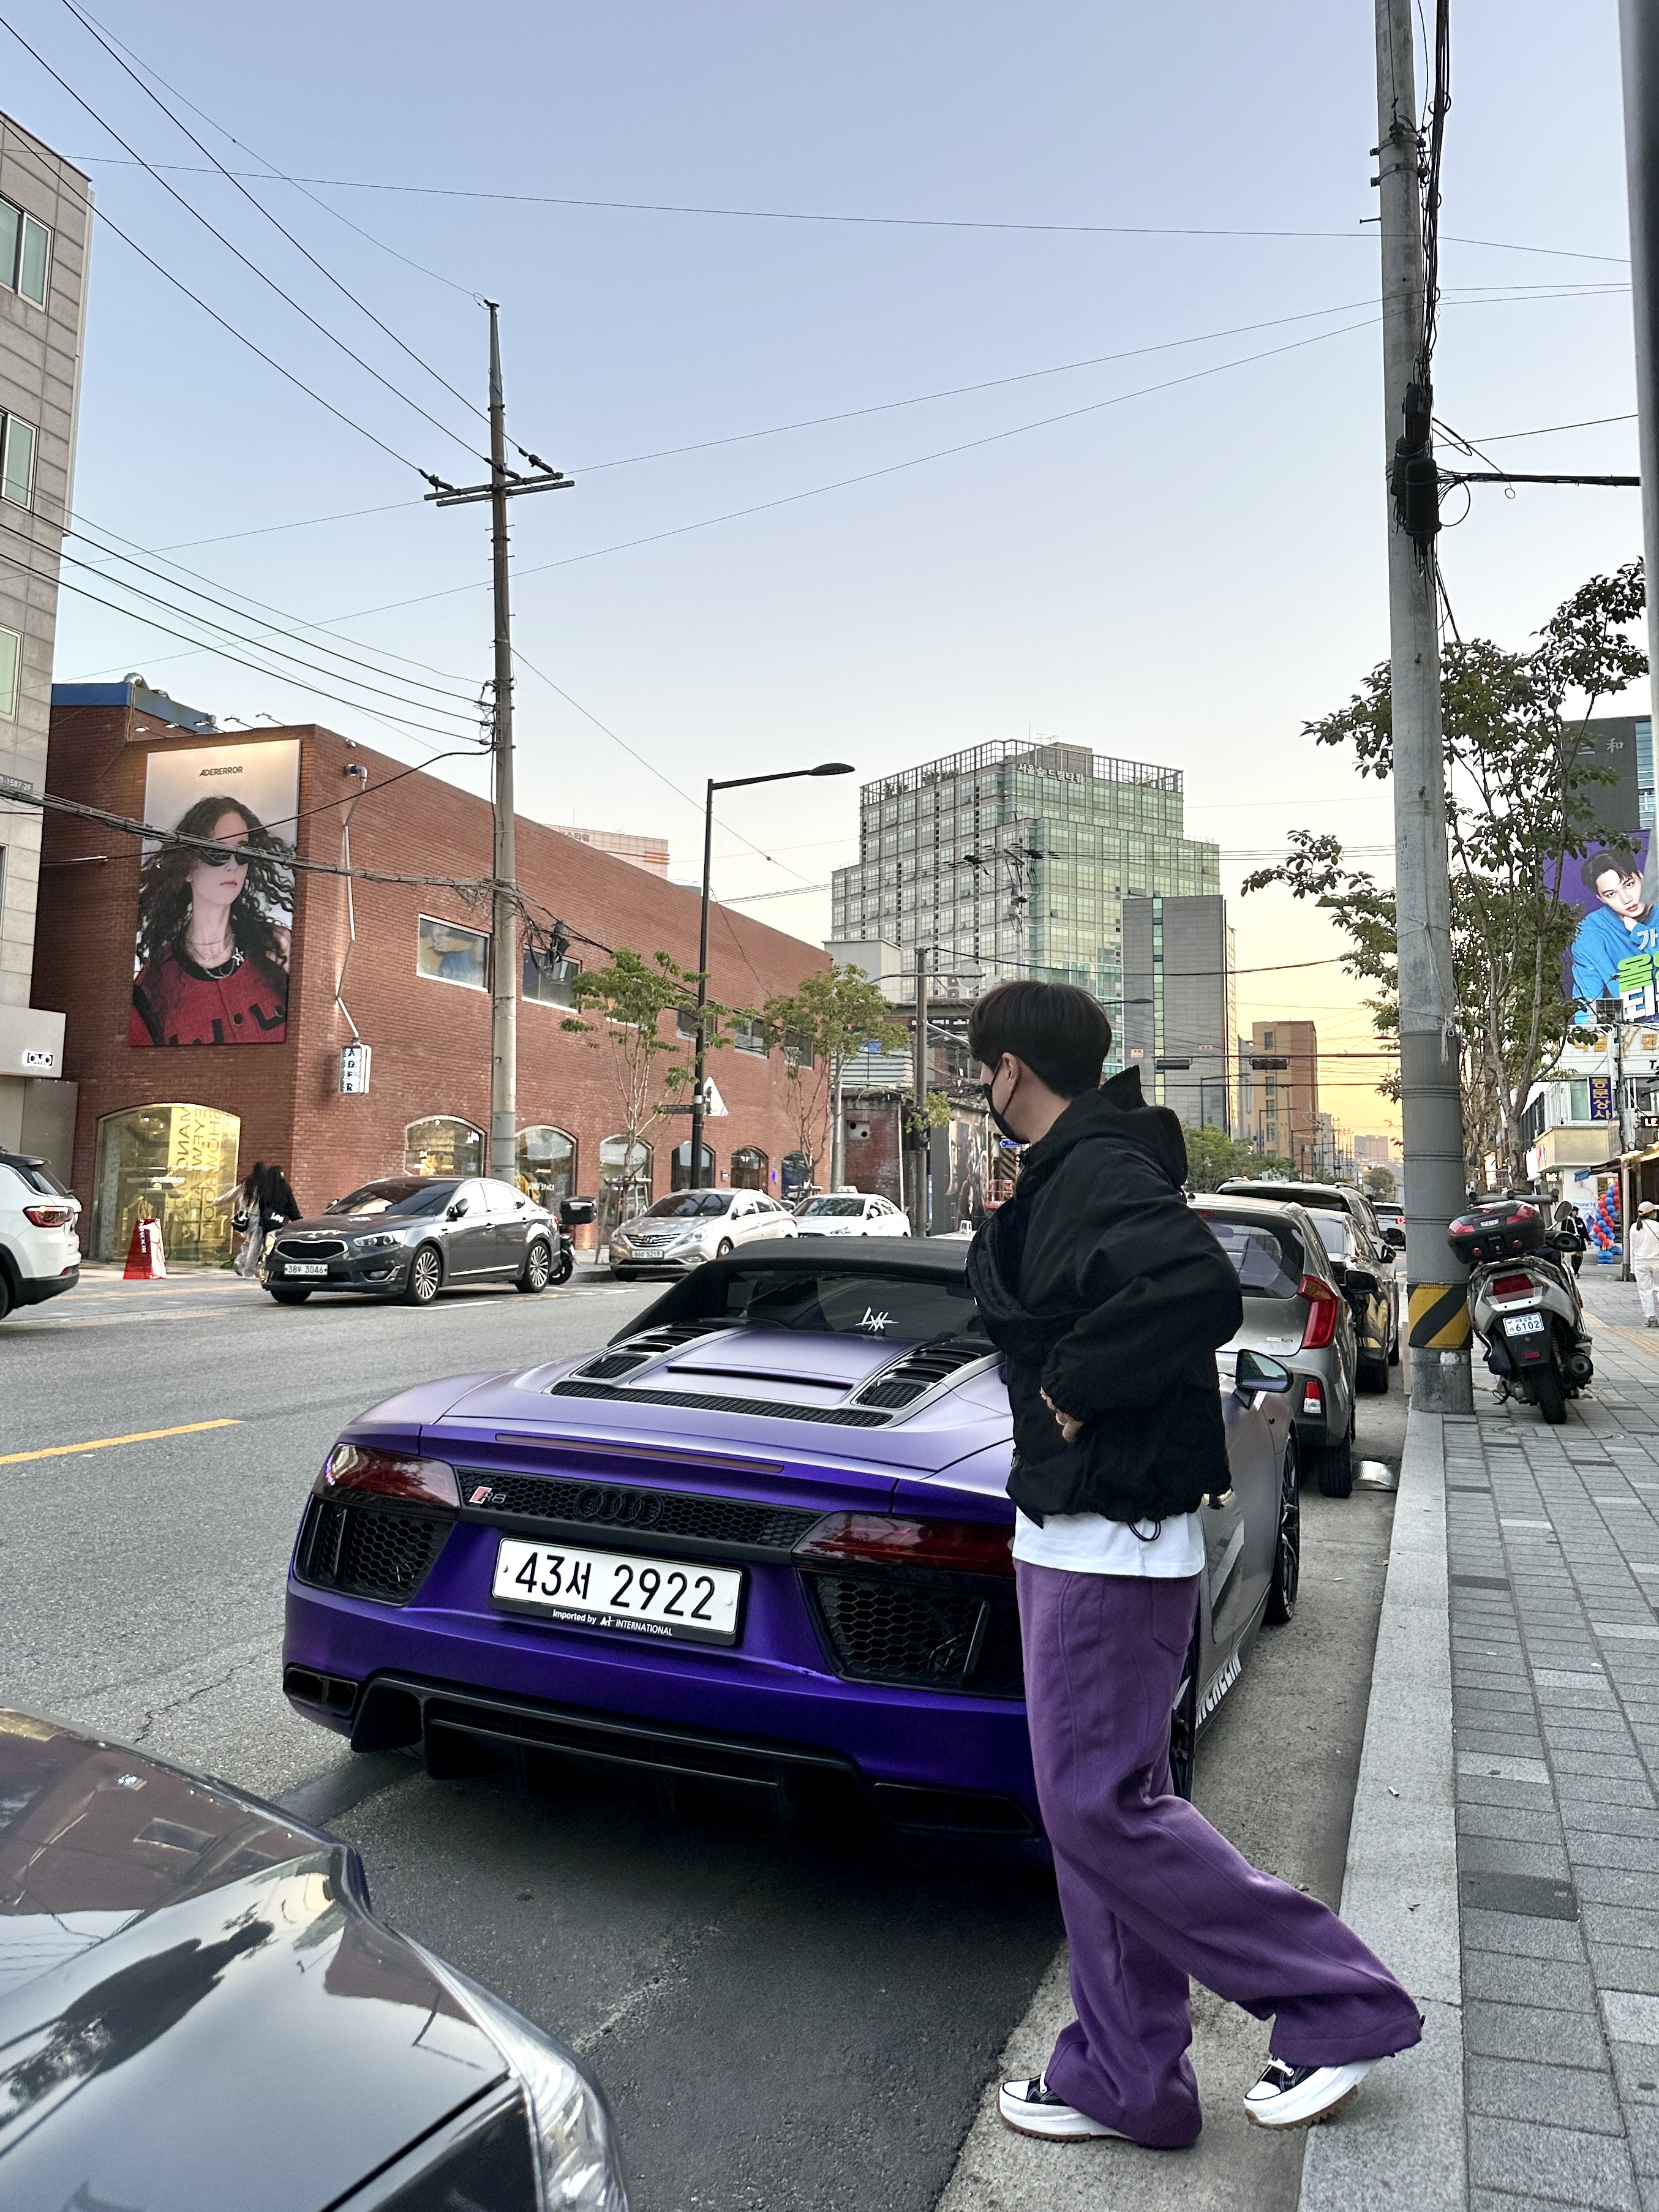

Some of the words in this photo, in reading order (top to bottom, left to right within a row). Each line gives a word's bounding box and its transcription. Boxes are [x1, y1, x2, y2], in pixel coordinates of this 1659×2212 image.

[199, 766, 243, 777] ADERERROR
[1018, 764, 1047, 778] 서울숲
[1047, 769, 1083, 784] 드림타워
[1516, 1320, 1541, 1331] 6102
[515, 1552, 592, 1600] 43서
[610, 1564, 715, 1620] 2922
[552, 1609, 586, 1622] Imported
[587, 1615, 596, 1625] by
[615, 1619, 673, 1636] INTERNATIONAL
